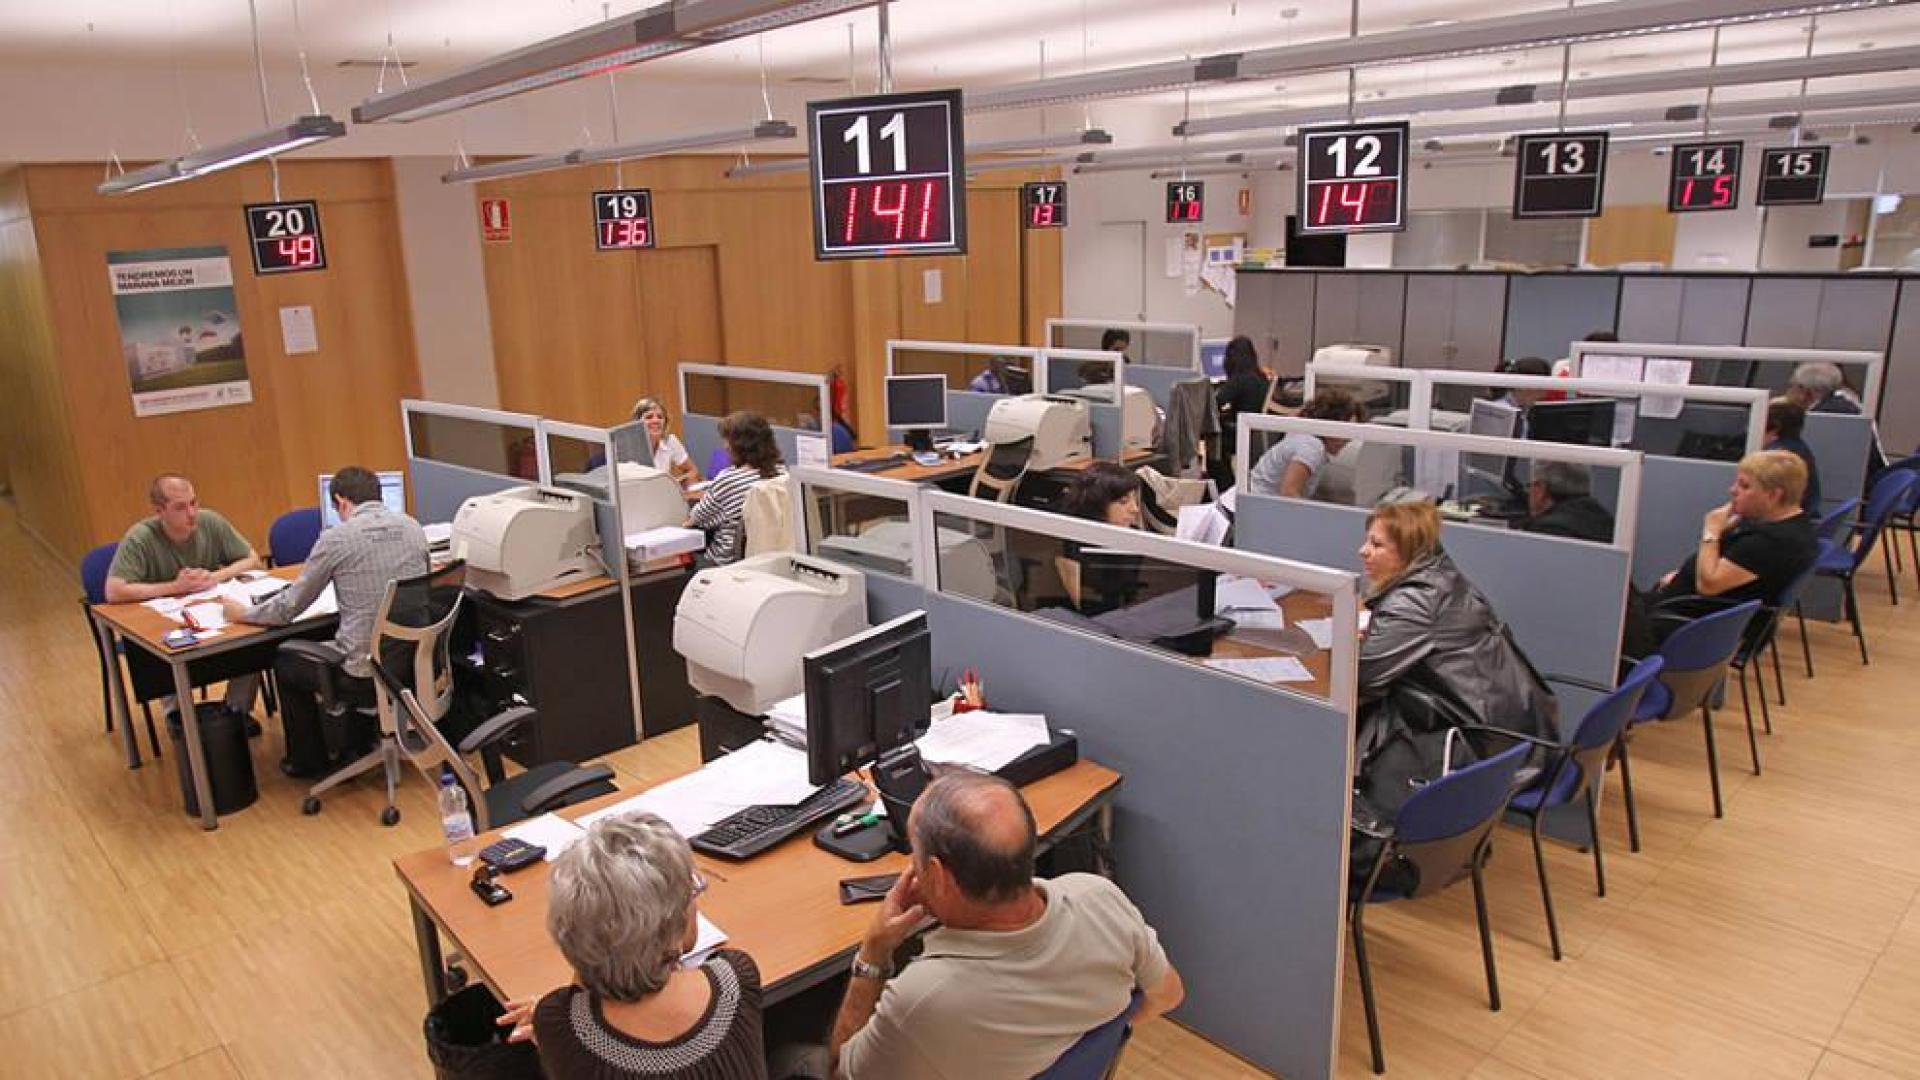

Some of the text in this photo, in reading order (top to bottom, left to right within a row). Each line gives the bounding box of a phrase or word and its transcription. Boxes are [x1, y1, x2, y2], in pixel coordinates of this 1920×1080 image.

[843, 112, 907, 174] 11
[1327, 135, 1381, 177] 12
[1540, 142, 1585, 174] 13
[1690, 149, 1725, 175] 14
[1777, 154, 1812, 176] 15
[607, 196, 638, 218] 19
[1036, 187, 1056, 203] 17
[1176, 186, 1196, 202] 16
[1319, 184, 1368, 224] 14
[265, 209, 304, 237] 20
[846, 182, 932, 241] 141
[605, 219, 646, 246] 136
[278, 235, 315, 265] 49
